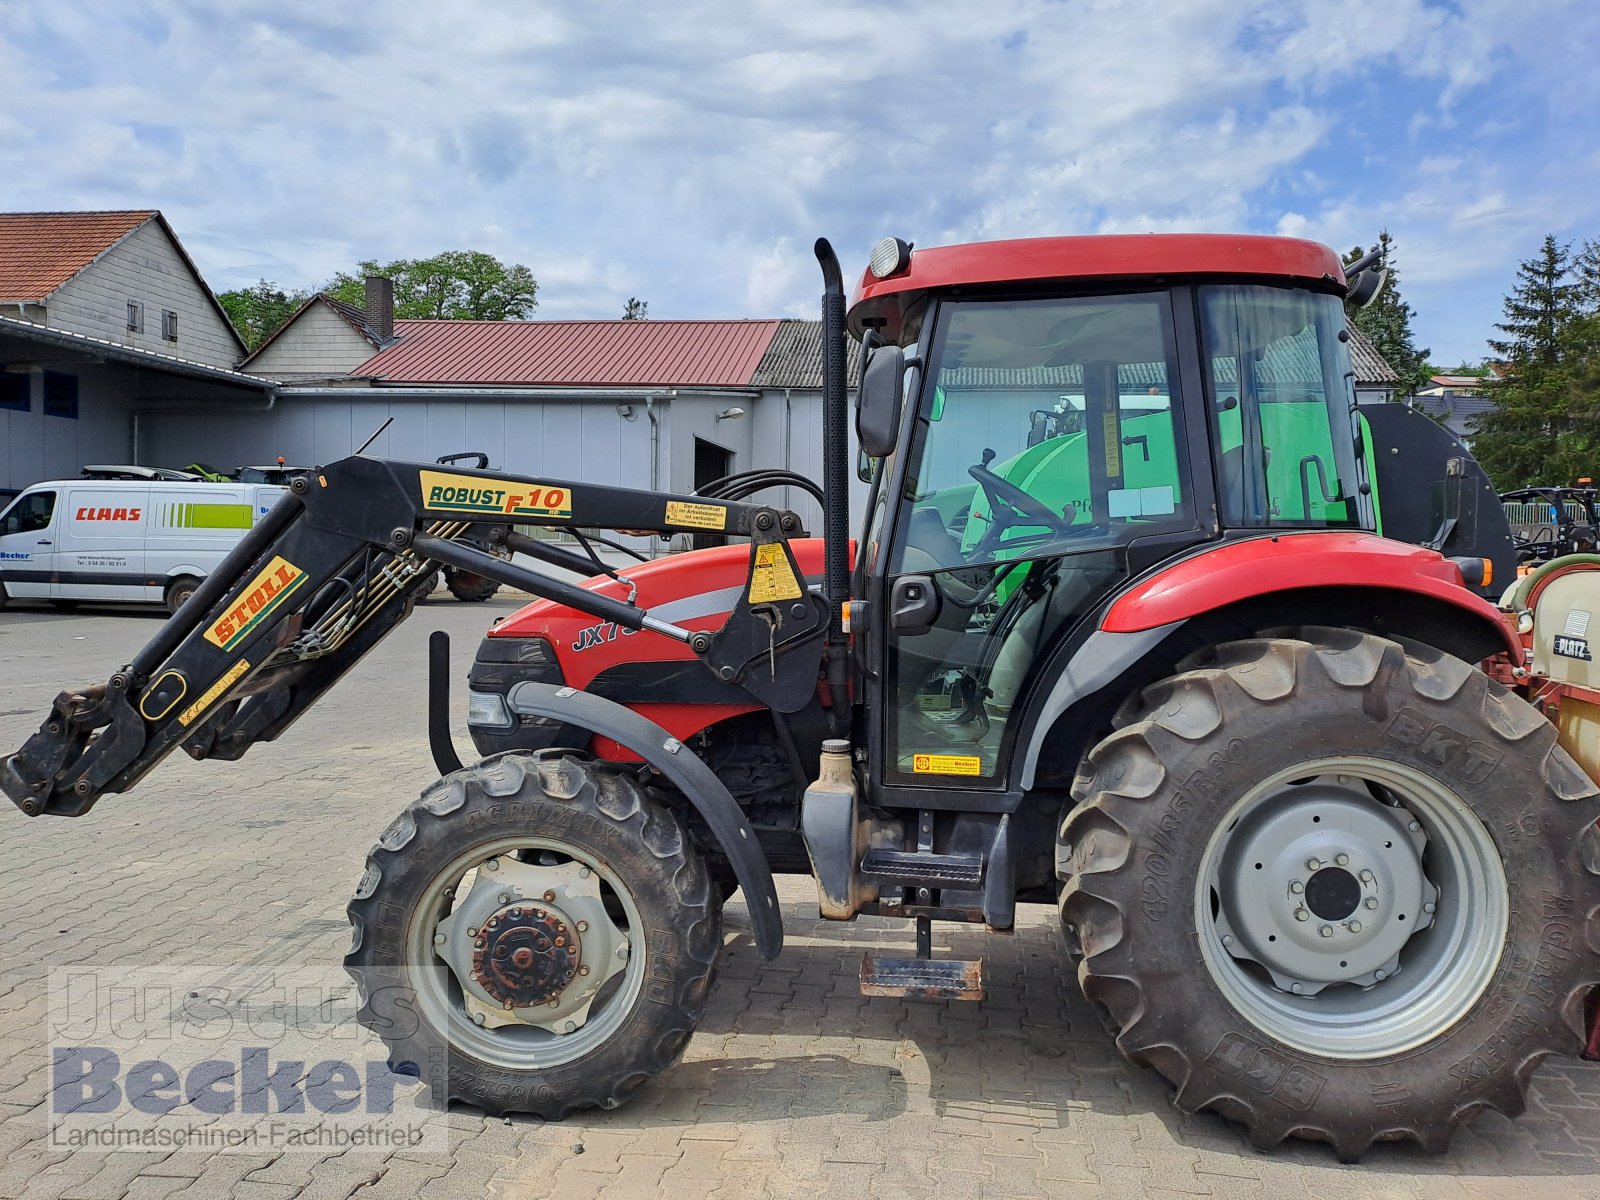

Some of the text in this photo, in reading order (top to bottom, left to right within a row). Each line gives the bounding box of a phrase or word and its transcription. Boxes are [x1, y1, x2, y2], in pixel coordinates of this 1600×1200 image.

[430, 486, 506, 505] ROBUST
[75, 508, 141, 521] CLAAS
[214, 564, 297, 644] STOLL
[1558, 638, 1586, 658] PLATZ
[1386, 709, 1501, 780] BKT
